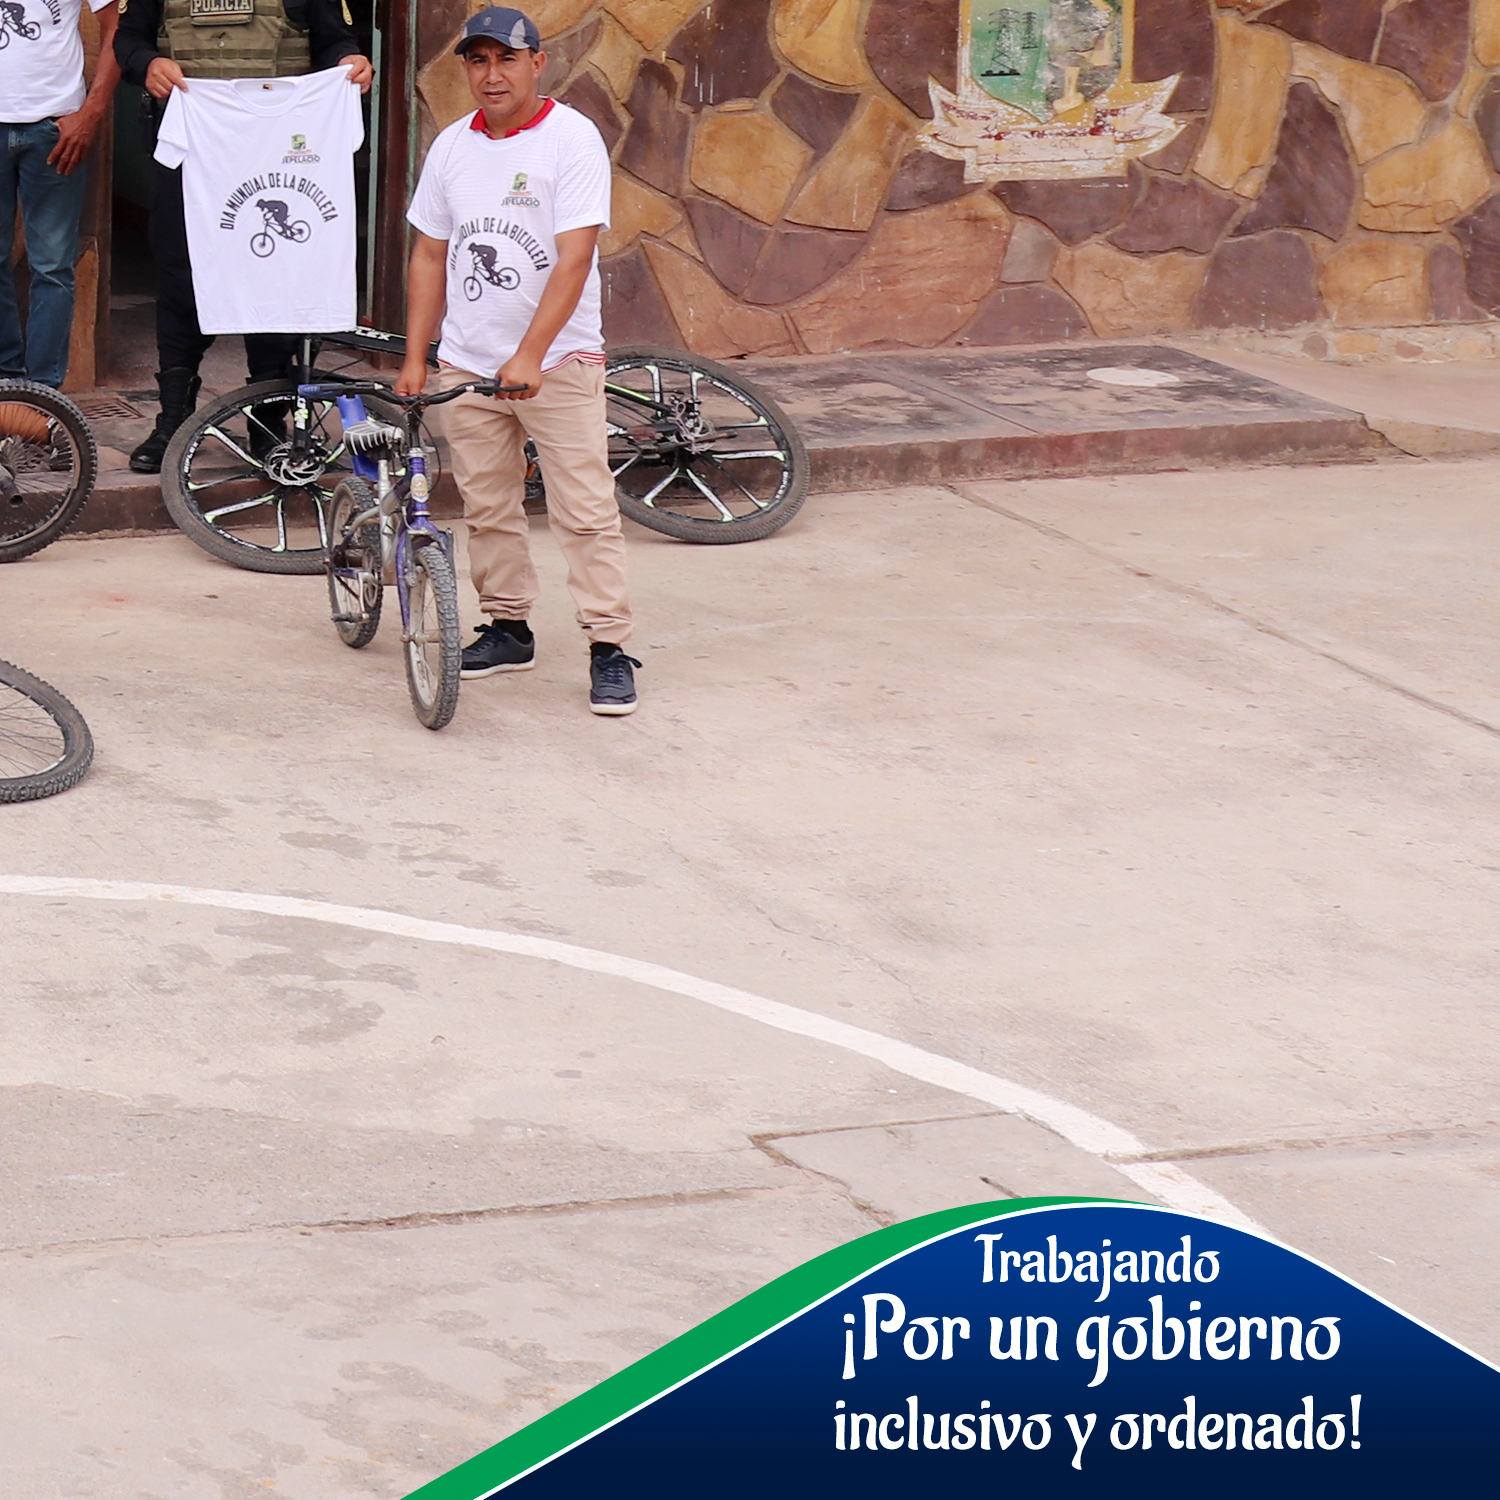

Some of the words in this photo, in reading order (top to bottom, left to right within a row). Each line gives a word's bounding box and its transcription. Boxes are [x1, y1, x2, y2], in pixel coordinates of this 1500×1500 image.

[282, 154, 321, 164] JEPELACIO
[268, 172, 281, 188] DE
[283, 173, 297, 189] LA
[225, 174, 268, 213] MUNDIAL
[297, 177, 339, 223] BICICLETA
[220, 211, 237, 230] DIA
[484, 217, 496, 232] DE
[497, 218, 510, 236] LA
[509, 224, 551, 272] BICICLETA
[775, 470, 789, 500] BIFLEX
